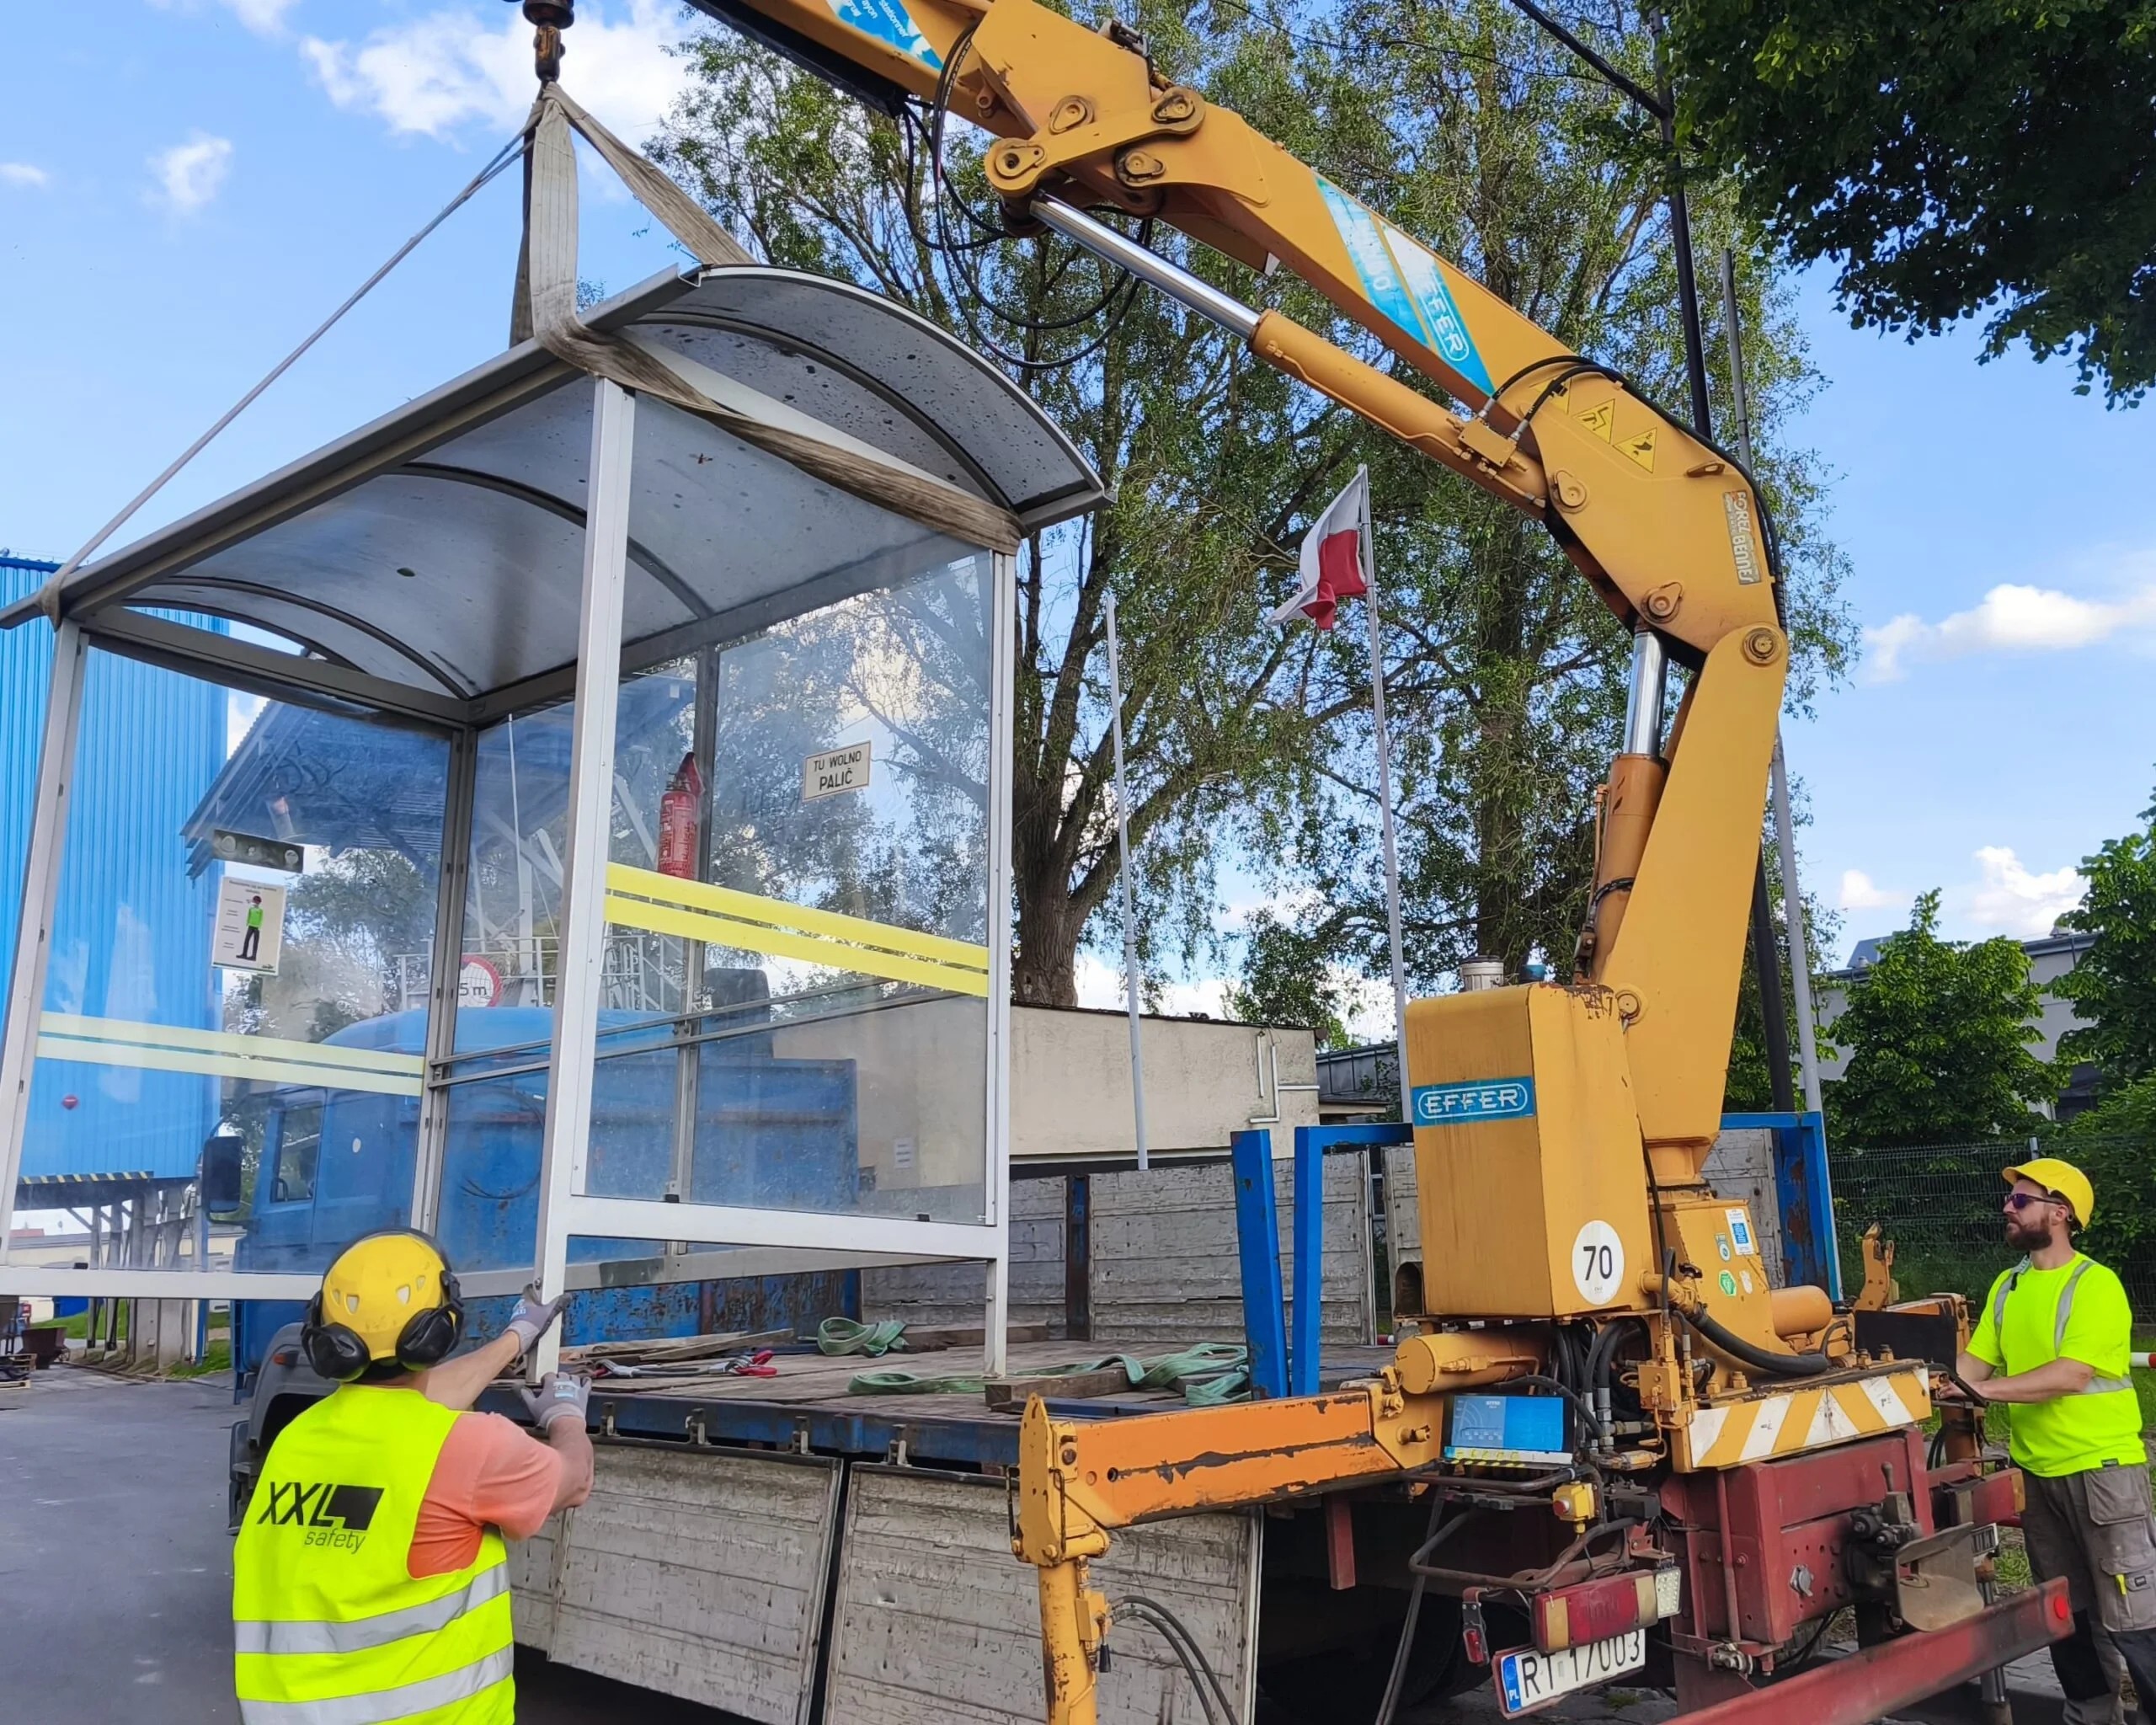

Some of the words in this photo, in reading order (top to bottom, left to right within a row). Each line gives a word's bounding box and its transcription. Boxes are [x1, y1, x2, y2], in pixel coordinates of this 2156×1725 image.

[862, 0, 878, 19] ayon
[814, 759, 825, 772] TU
[830, 750, 862, 768] WOLNO
[1425, 1088, 1518, 1114] EFFER
[1582, 1245, 1612, 1281] 70
[256, 1481, 334, 1528] XXL
[304, 1528, 366, 1555] safety
[1508, 1689, 1519, 1701] PL
